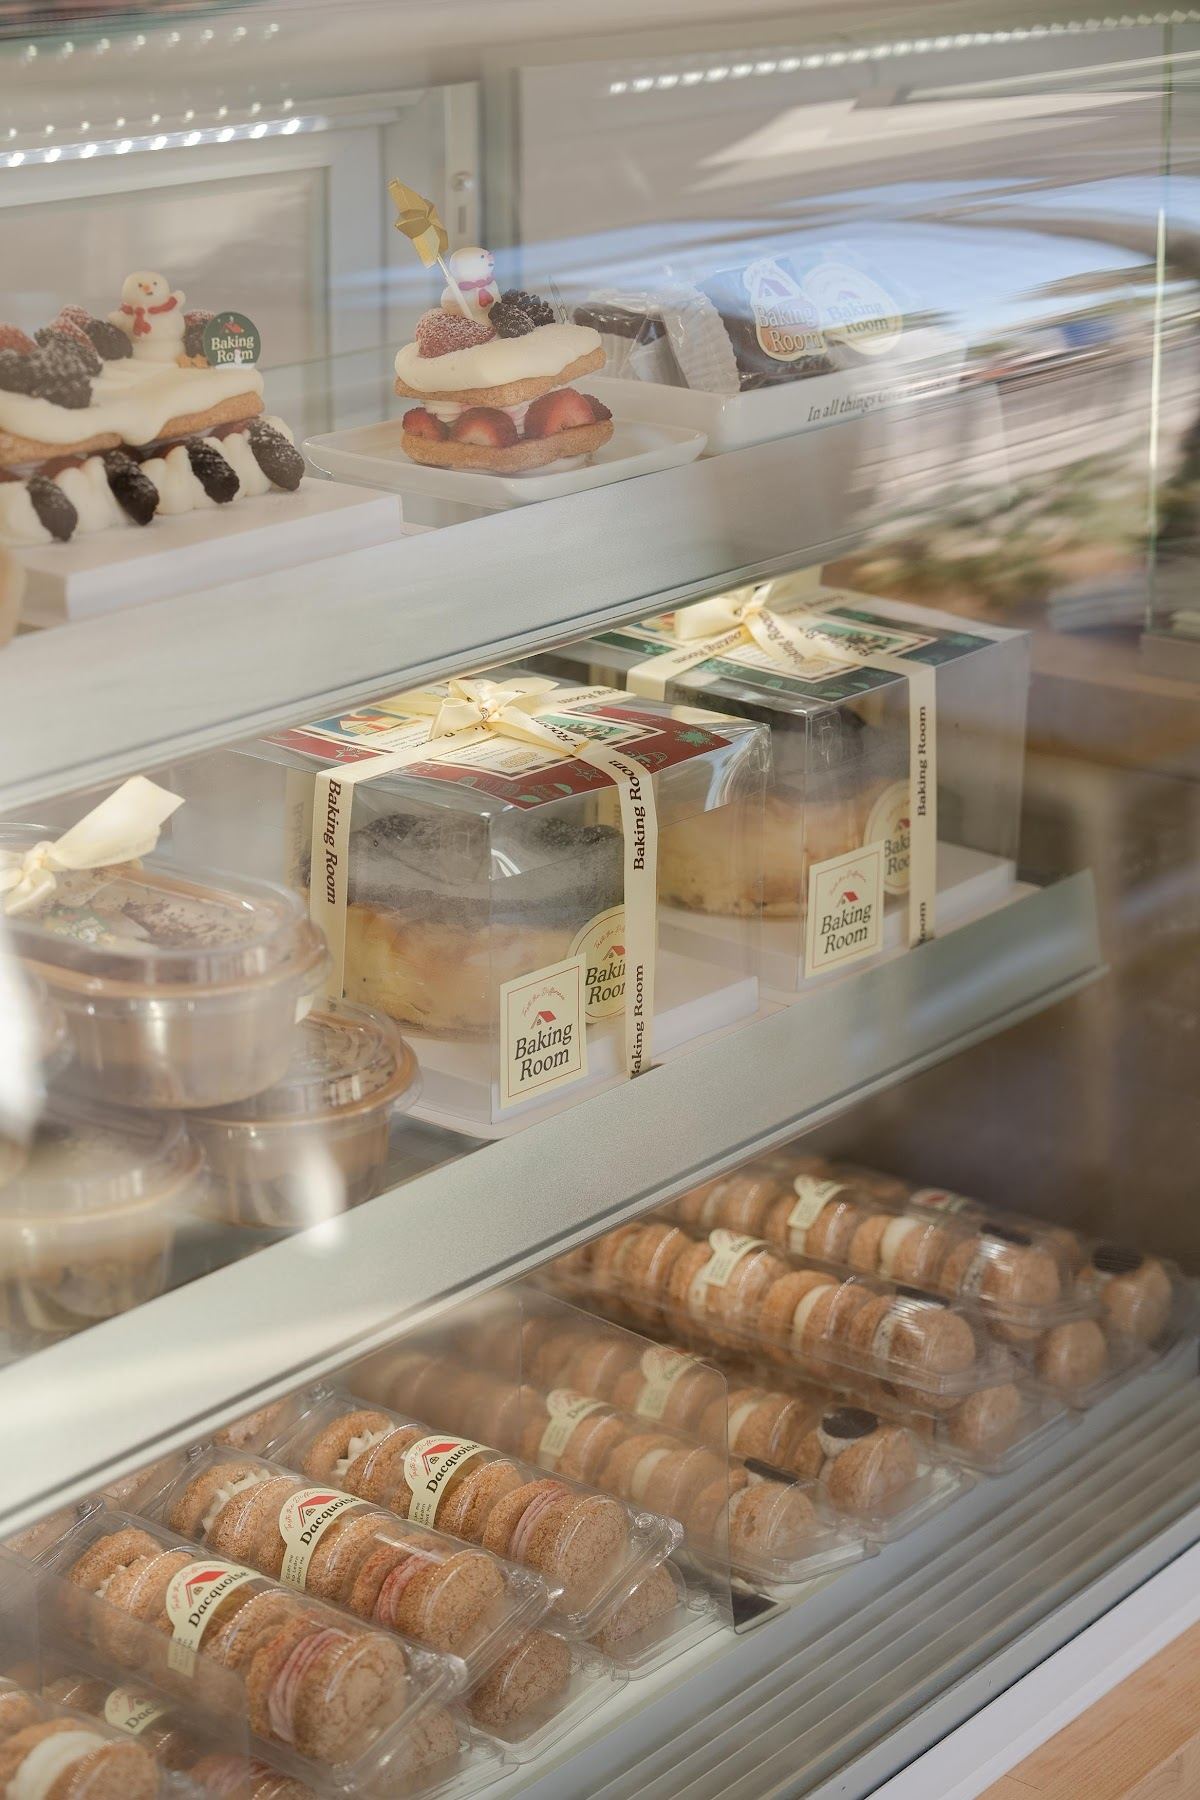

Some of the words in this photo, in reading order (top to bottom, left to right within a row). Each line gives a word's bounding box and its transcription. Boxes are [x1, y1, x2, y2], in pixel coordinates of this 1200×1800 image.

[754, 302, 818, 328] Baking
[828, 302, 883, 321] Baking
[845, 317, 889, 334] Room
[211, 335, 254, 351] Baking
[217, 349, 253, 363] Rom
[770, 330, 825, 352] Room
[807, 405, 820, 422] In
[822, 399, 839, 417] all
[840, 395, 877, 414] things
[918, 706, 927, 755] Room
[608, 760, 642, 801] Room
[918, 759, 928, 817] Baking
[323, 779, 342, 848] Baking
[633, 806, 646, 870] Baking
[884, 830, 910, 858] Baki
[325, 848, 338, 905] Room
[887, 856, 910, 876] Roo
[820, 904, 872, 936] Baking
[919, 902, 927, 943] oom
[824, 927, 868, 955] Room
[585, 959, 625, 986] Baki
[634, 964, 644, 1017] Room
[514, 1023, 573, 1061] Baking
[519, 1048, 570, 1082] Room
[425, 1443, 480, 1494] Dacquoise
[300, 1496, 358, 1546] Dacquoise
[188, 1571, 249, 1628] Dacquoise
